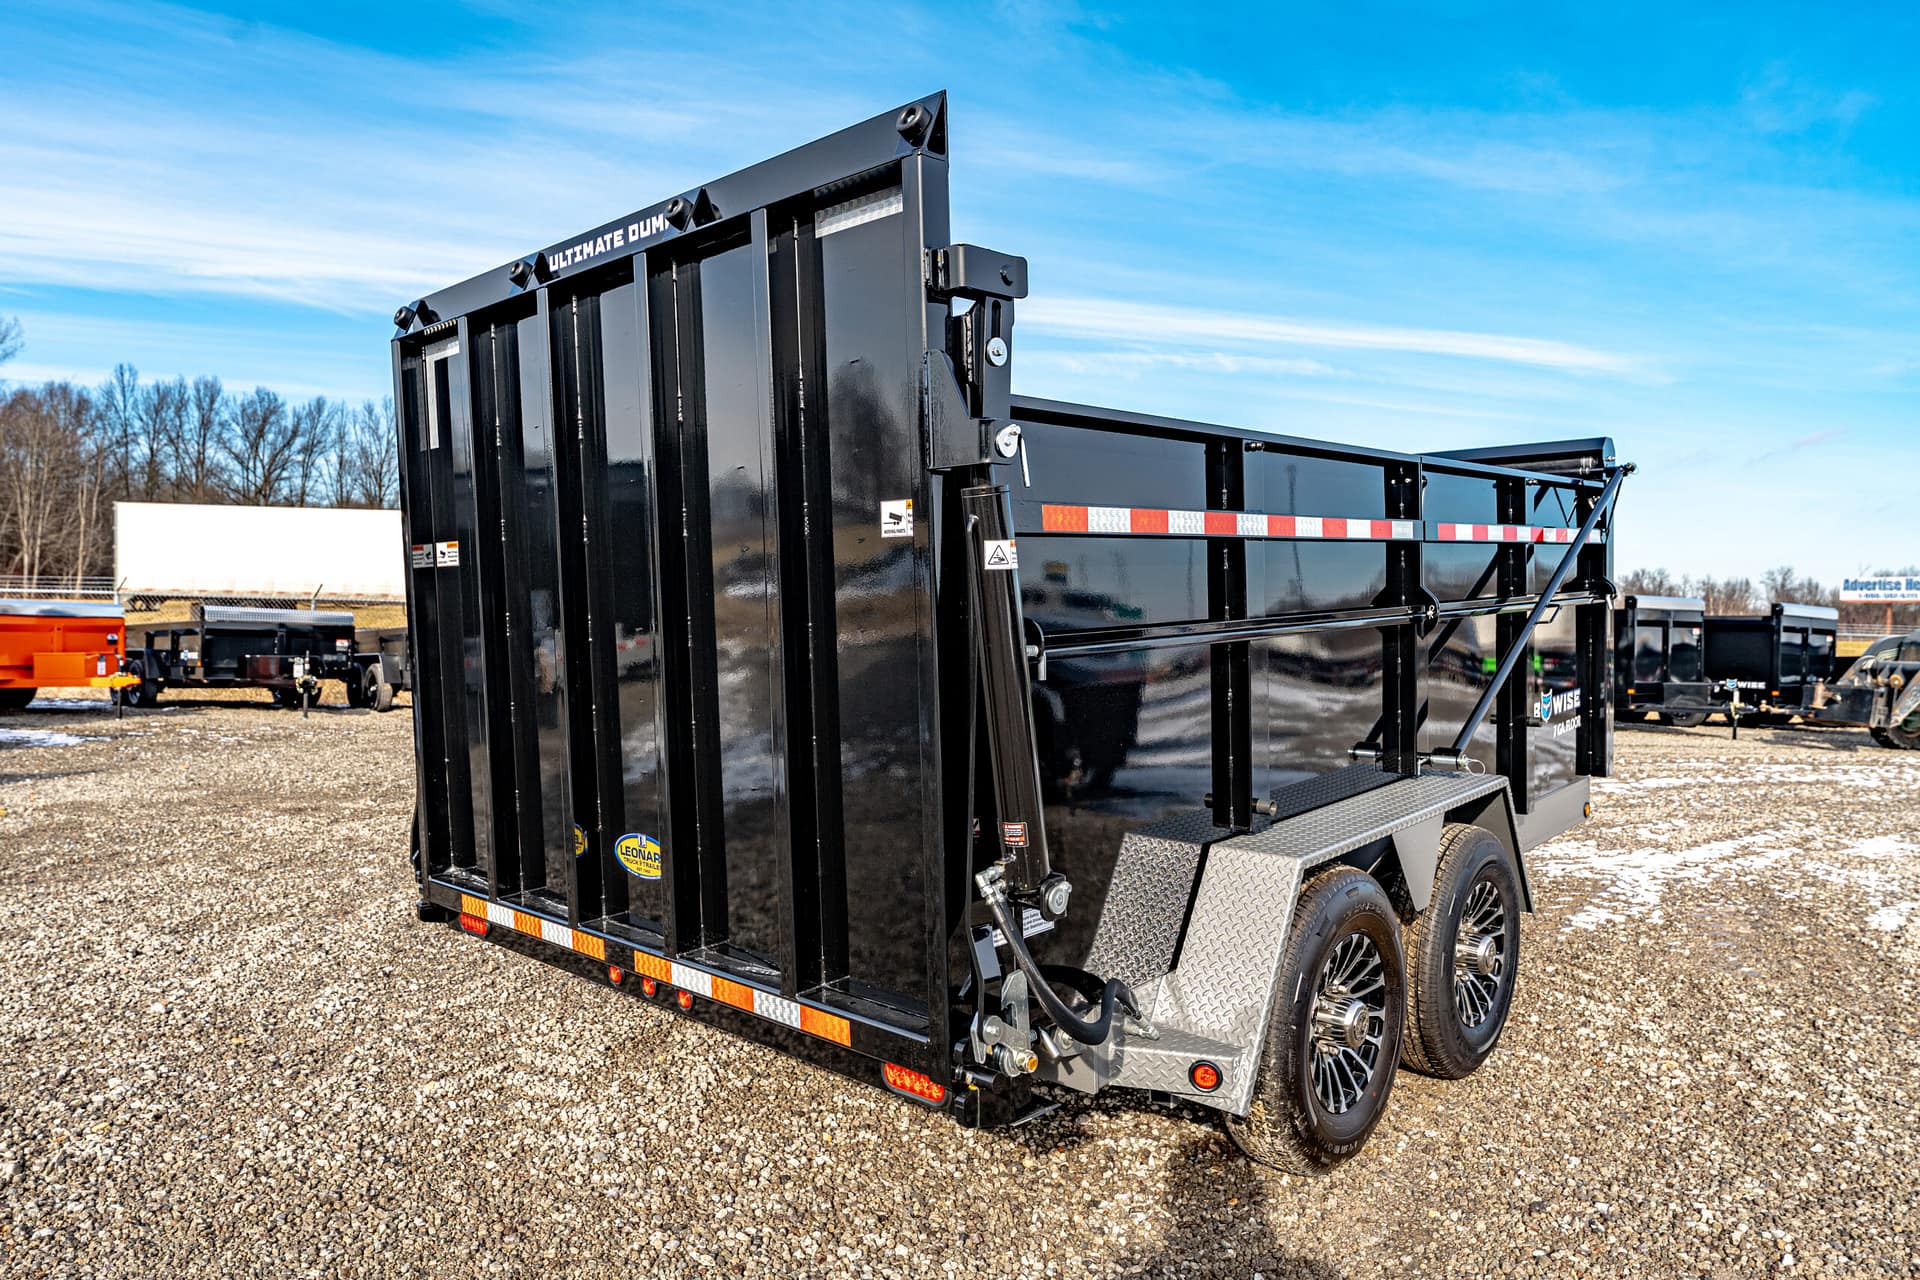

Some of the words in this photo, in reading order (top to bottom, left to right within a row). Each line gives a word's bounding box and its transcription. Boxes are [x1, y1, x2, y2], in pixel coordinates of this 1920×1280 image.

[550, 228, 625, 272] ULTIMATE
[1843, 578, 1902, 591] Advertise
[1905, 578, 1920, 591] He
[619, 844, 661, 864] LEONAR
[643, 861, 661, 871] TRAILE
